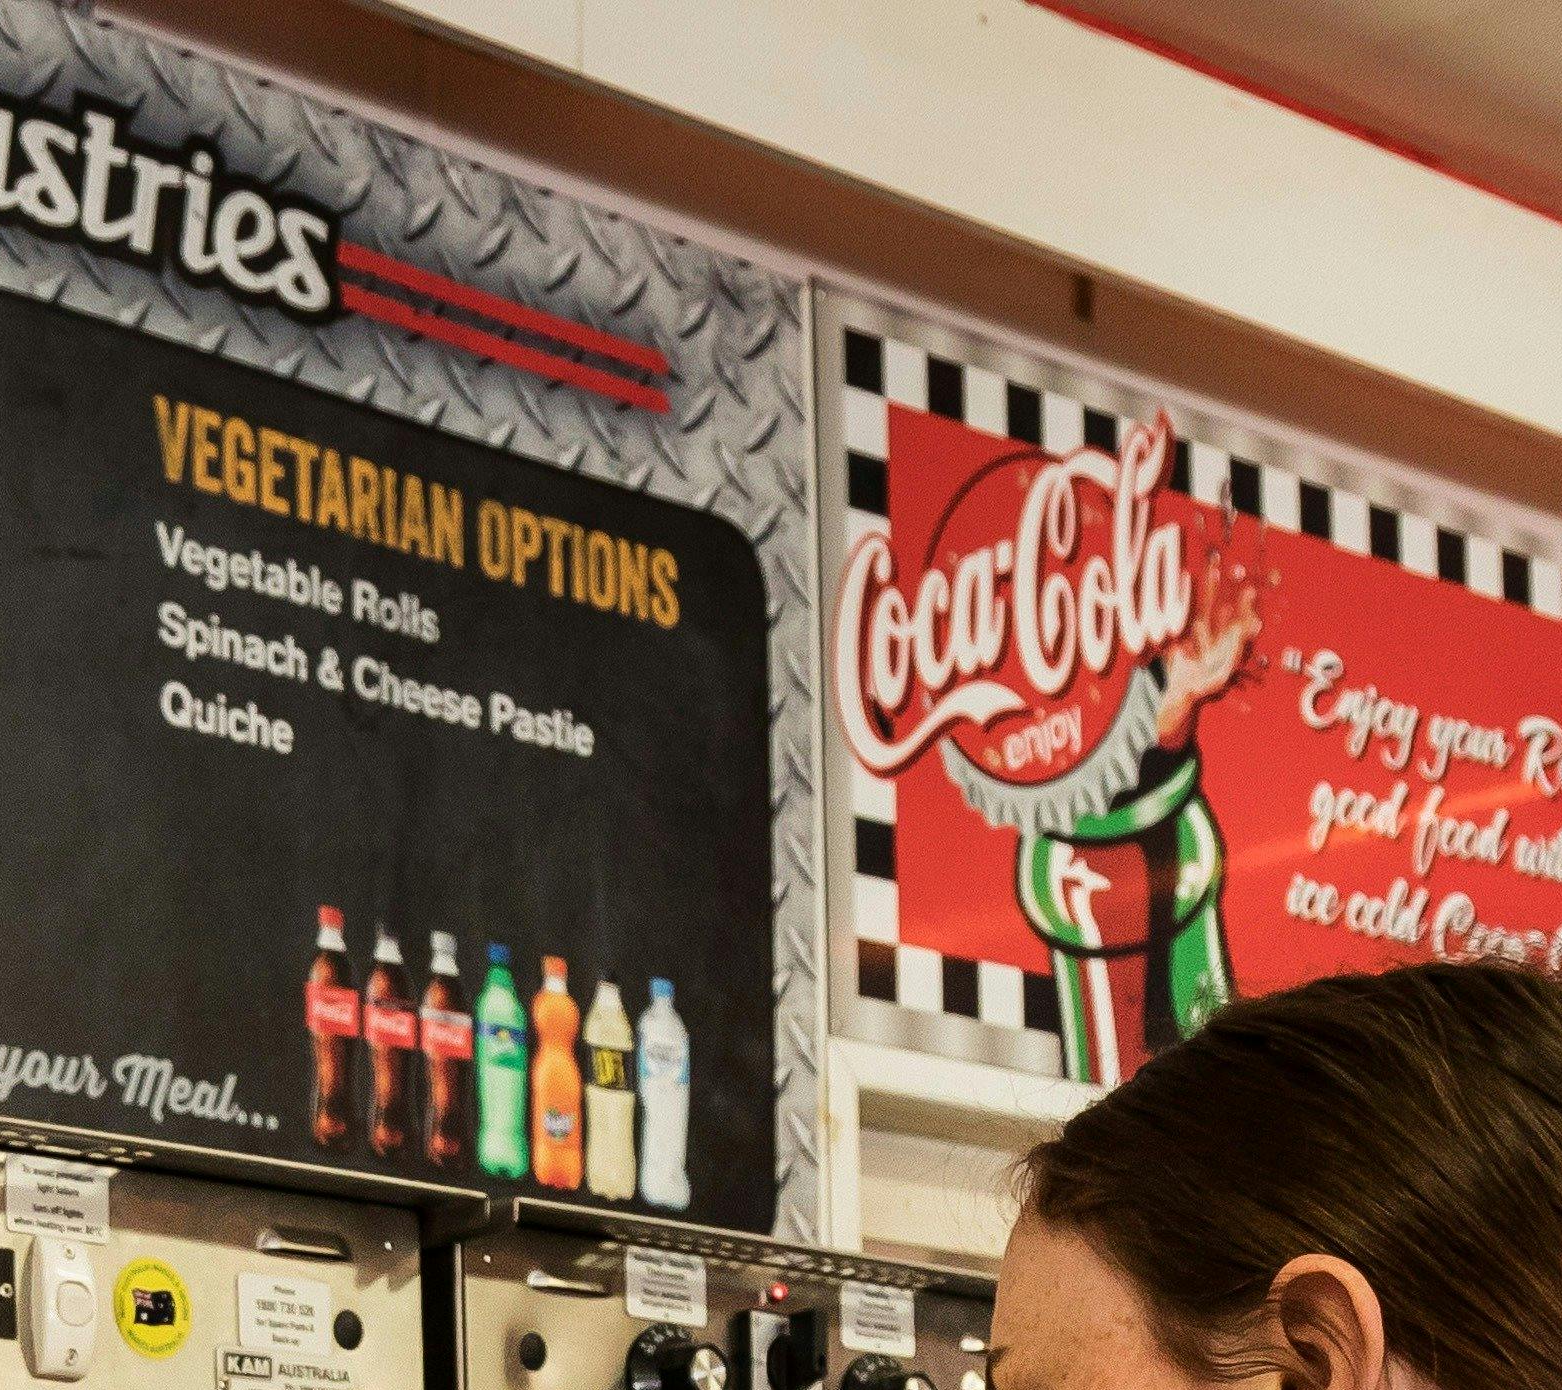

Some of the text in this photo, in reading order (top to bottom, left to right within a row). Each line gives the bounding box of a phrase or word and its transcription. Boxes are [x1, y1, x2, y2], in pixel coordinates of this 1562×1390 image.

[153, 393, 680, 631] VEGETARIAN OPTIONS
[155, 521, 441, 646] Vegetable Rolls
[155, 602, 596, 759] Spinach & Cheese Pastie
[158, 680, 295, 756] Quiche
[1417, 713, 1514, 783] your
[1307, 780, 1412, 853] good
[1411, 785, 1511, 878] food
[1286, 871, 1341, 927] ice
[1344, 876, 1430, 947] cold
[112, 1050, 280, 1132] Meal...
[226, 1353, 350, 1382] KAM AUSTRALIA
